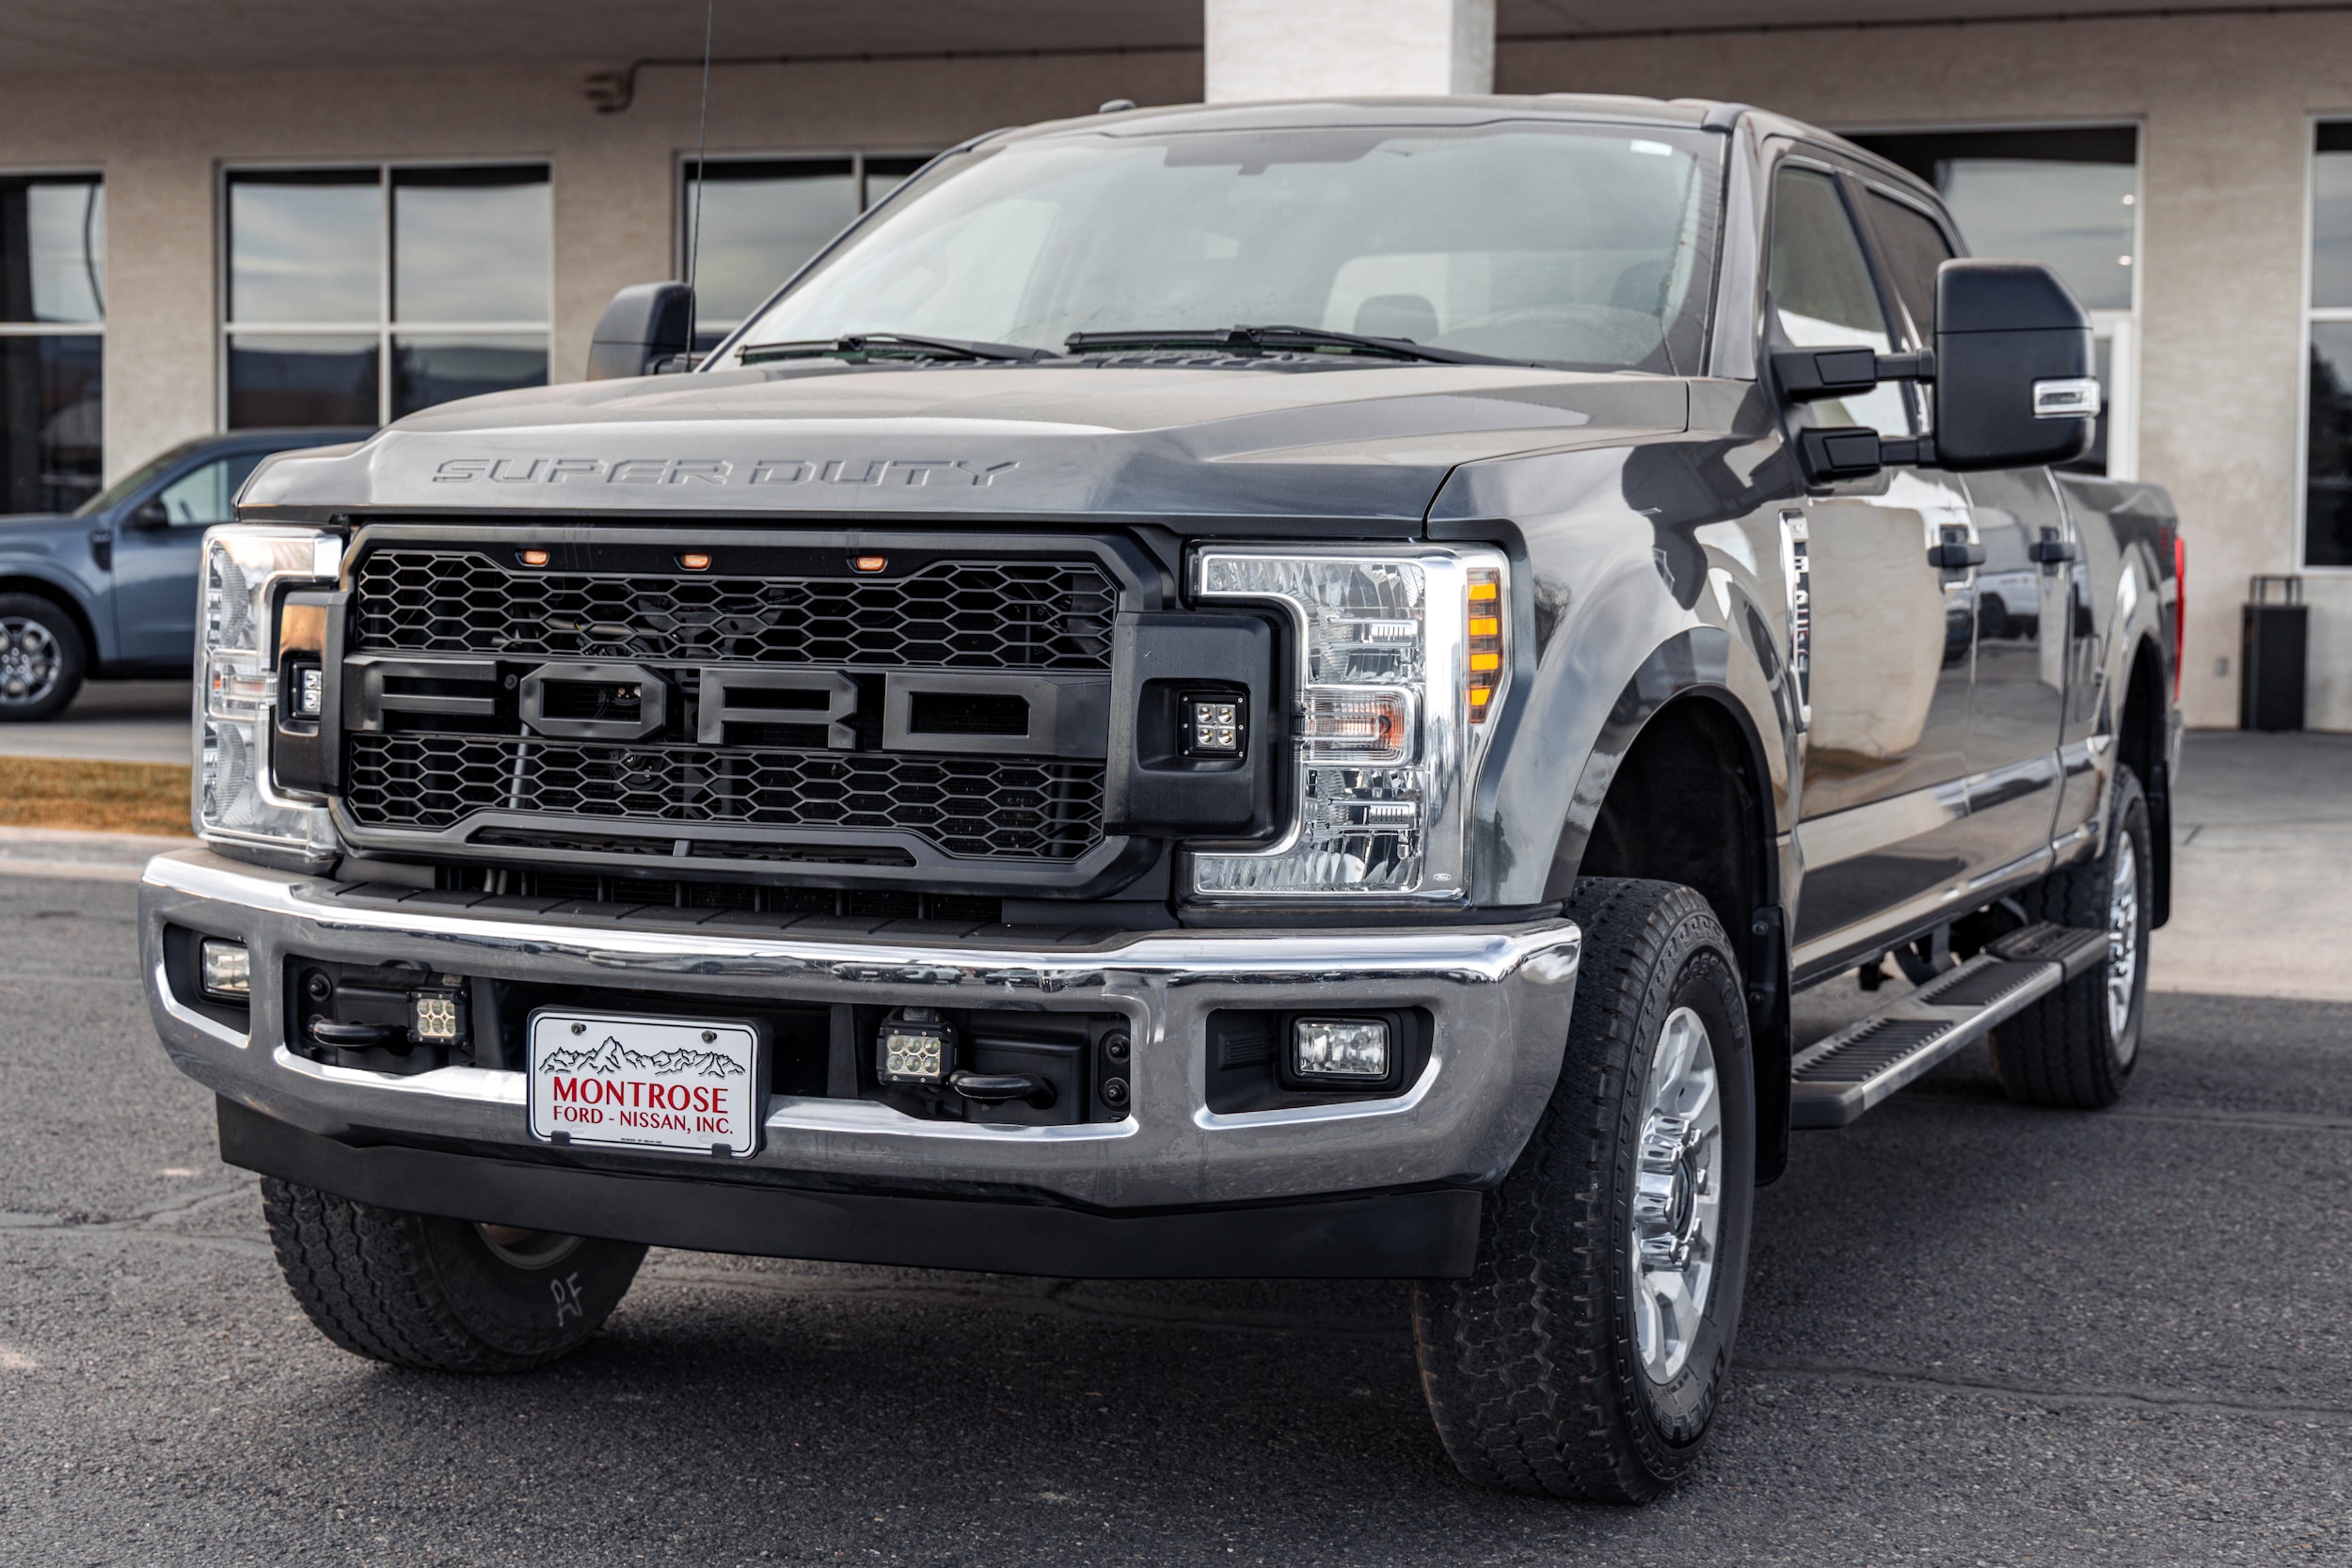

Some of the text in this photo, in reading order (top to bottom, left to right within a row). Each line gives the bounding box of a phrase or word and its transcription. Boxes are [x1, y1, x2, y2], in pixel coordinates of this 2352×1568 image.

[432, 458, 1021, 487] SUPER DUTY
[346, 657, 1059, 758] FORD
[553, 1076, 729, 1114] MONTROSE
[553, 1105, 603, 1124] FORD
[620, 1110, 691, 1134] NISSAN,
[696, 1117, 733, 1134] INC.
